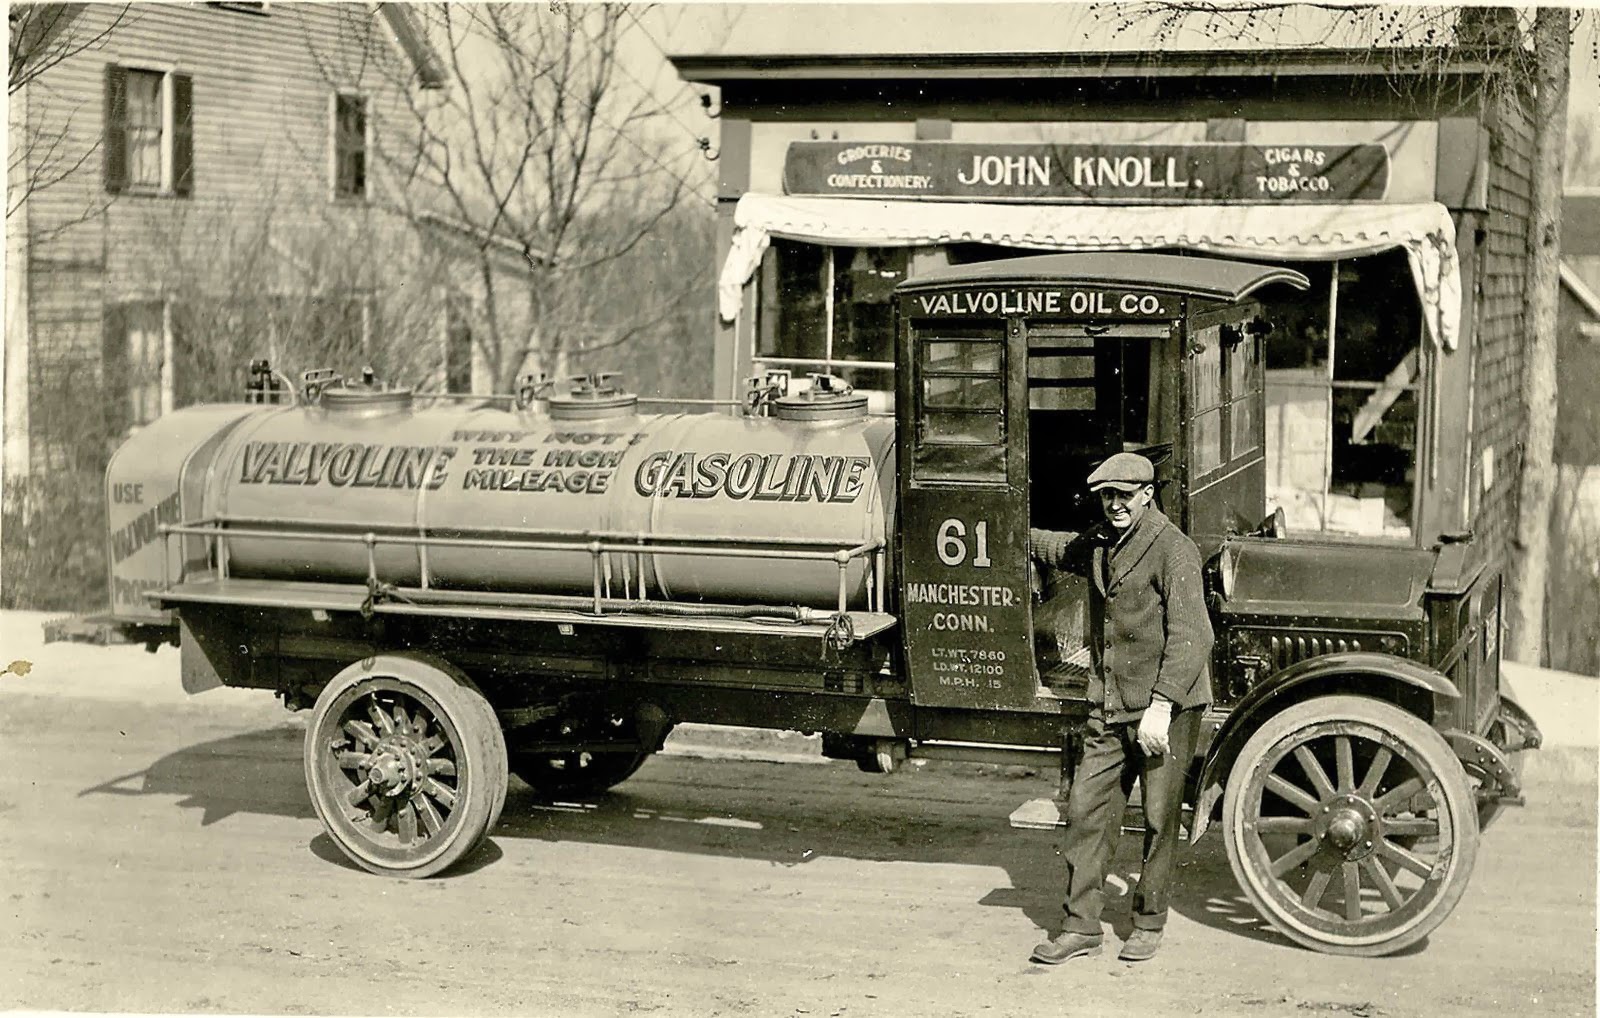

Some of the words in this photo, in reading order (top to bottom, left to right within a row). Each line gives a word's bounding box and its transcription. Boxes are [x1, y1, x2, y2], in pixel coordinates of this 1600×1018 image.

[837, 145, 912, 165] GROCERIES
[1264, 147, 1326, 165] CIGARS
[870, 160, 883, 174] &
[957, 155, 1050, 185] JOHN
[1288, 163, 1300, 177] &
[919, 292, 1061, 314] VALVOLINE
[1069, 292, 1113, 314] OIL
[1119, 294, 1166, 314] CO.
[240, 441, 457, 490] VALVOLINE
[472, 448, 537, 466] THE
[543, 449, 628, 468] HIGH
[462, 469, 613, 494] MILEAGE
[634, 450, 871, 503] GASOLINE
[113, 482, 144, 505] USE
[936, 518, 992, 568] 61
[933, 613, 995, 632] CONN.
[969, 649, 1006, 661] 7860
